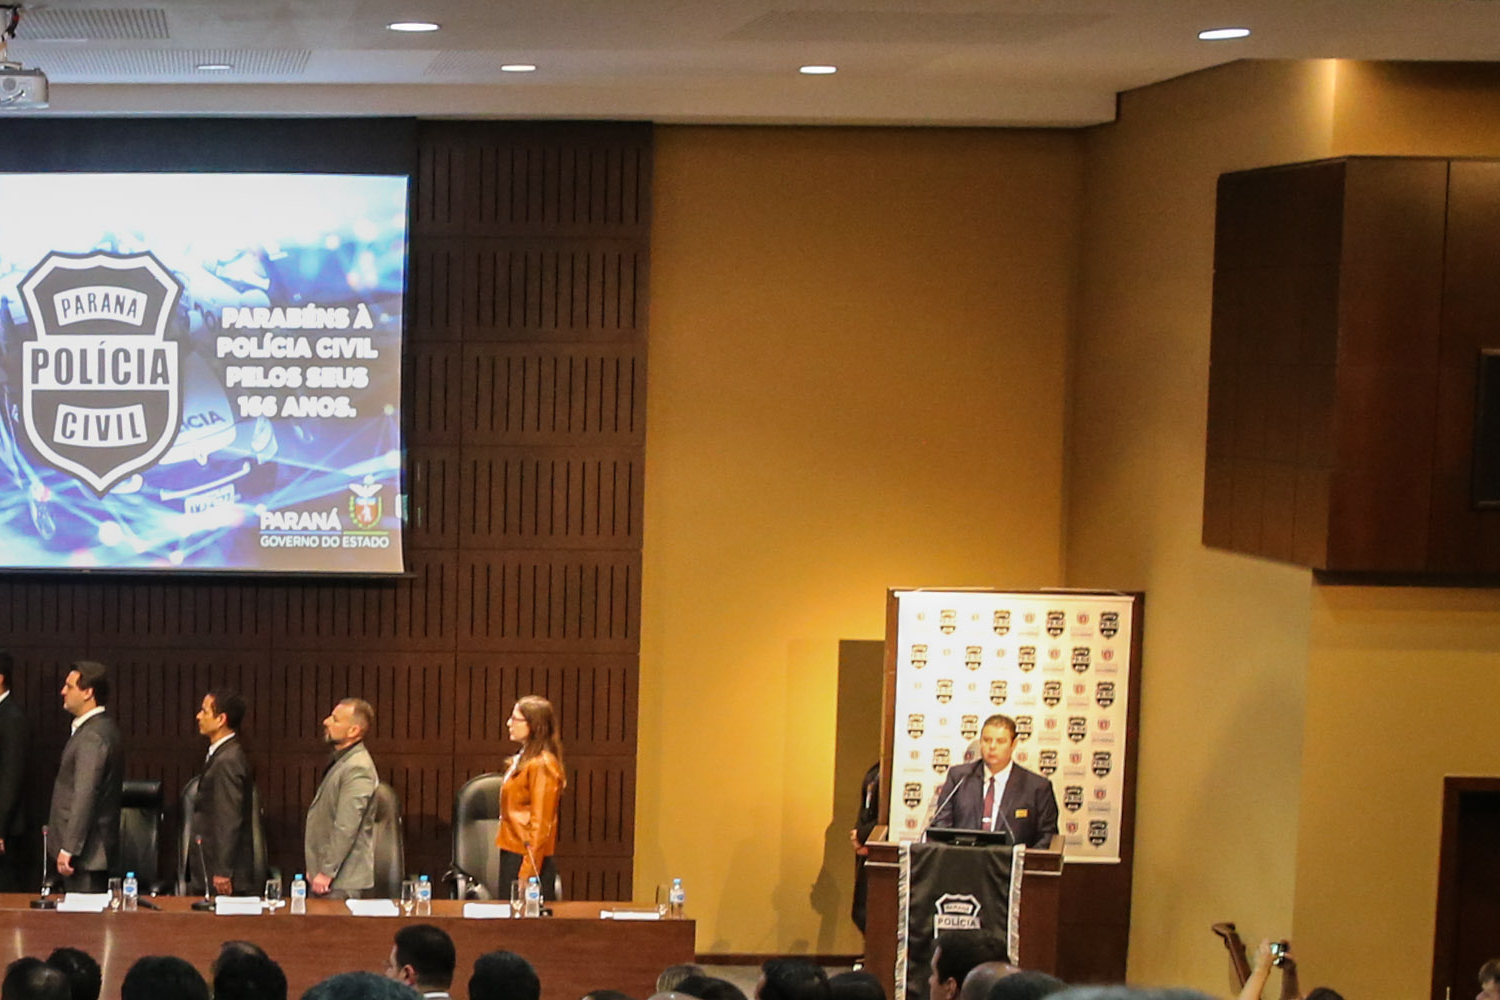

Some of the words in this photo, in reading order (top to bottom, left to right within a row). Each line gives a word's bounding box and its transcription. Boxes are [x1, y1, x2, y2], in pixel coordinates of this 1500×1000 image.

[222, 303, 350, 329] PARABÉNS
[352, 303, 374, 329] À
[216, 332, 312, 358] POLÍCIA
[316, 337, 379, 359] CIVIL
[31, 341, 170, 385] POLÍCIA
[226, 366, 302, 388] PELOS
[305, 366, 369, 389] SEUS
[237, 395, 277, 418] 166
[281, 396, 357, 418] ANOS.
[61, 412, 141, 441] CIVIL
[260, 507, 342, 531] PARANÁ
[260, 535, 320, 548] GOVERNO
[321, 535, 340, 548] DO
[342, 535, 390, 549] ESTADO
